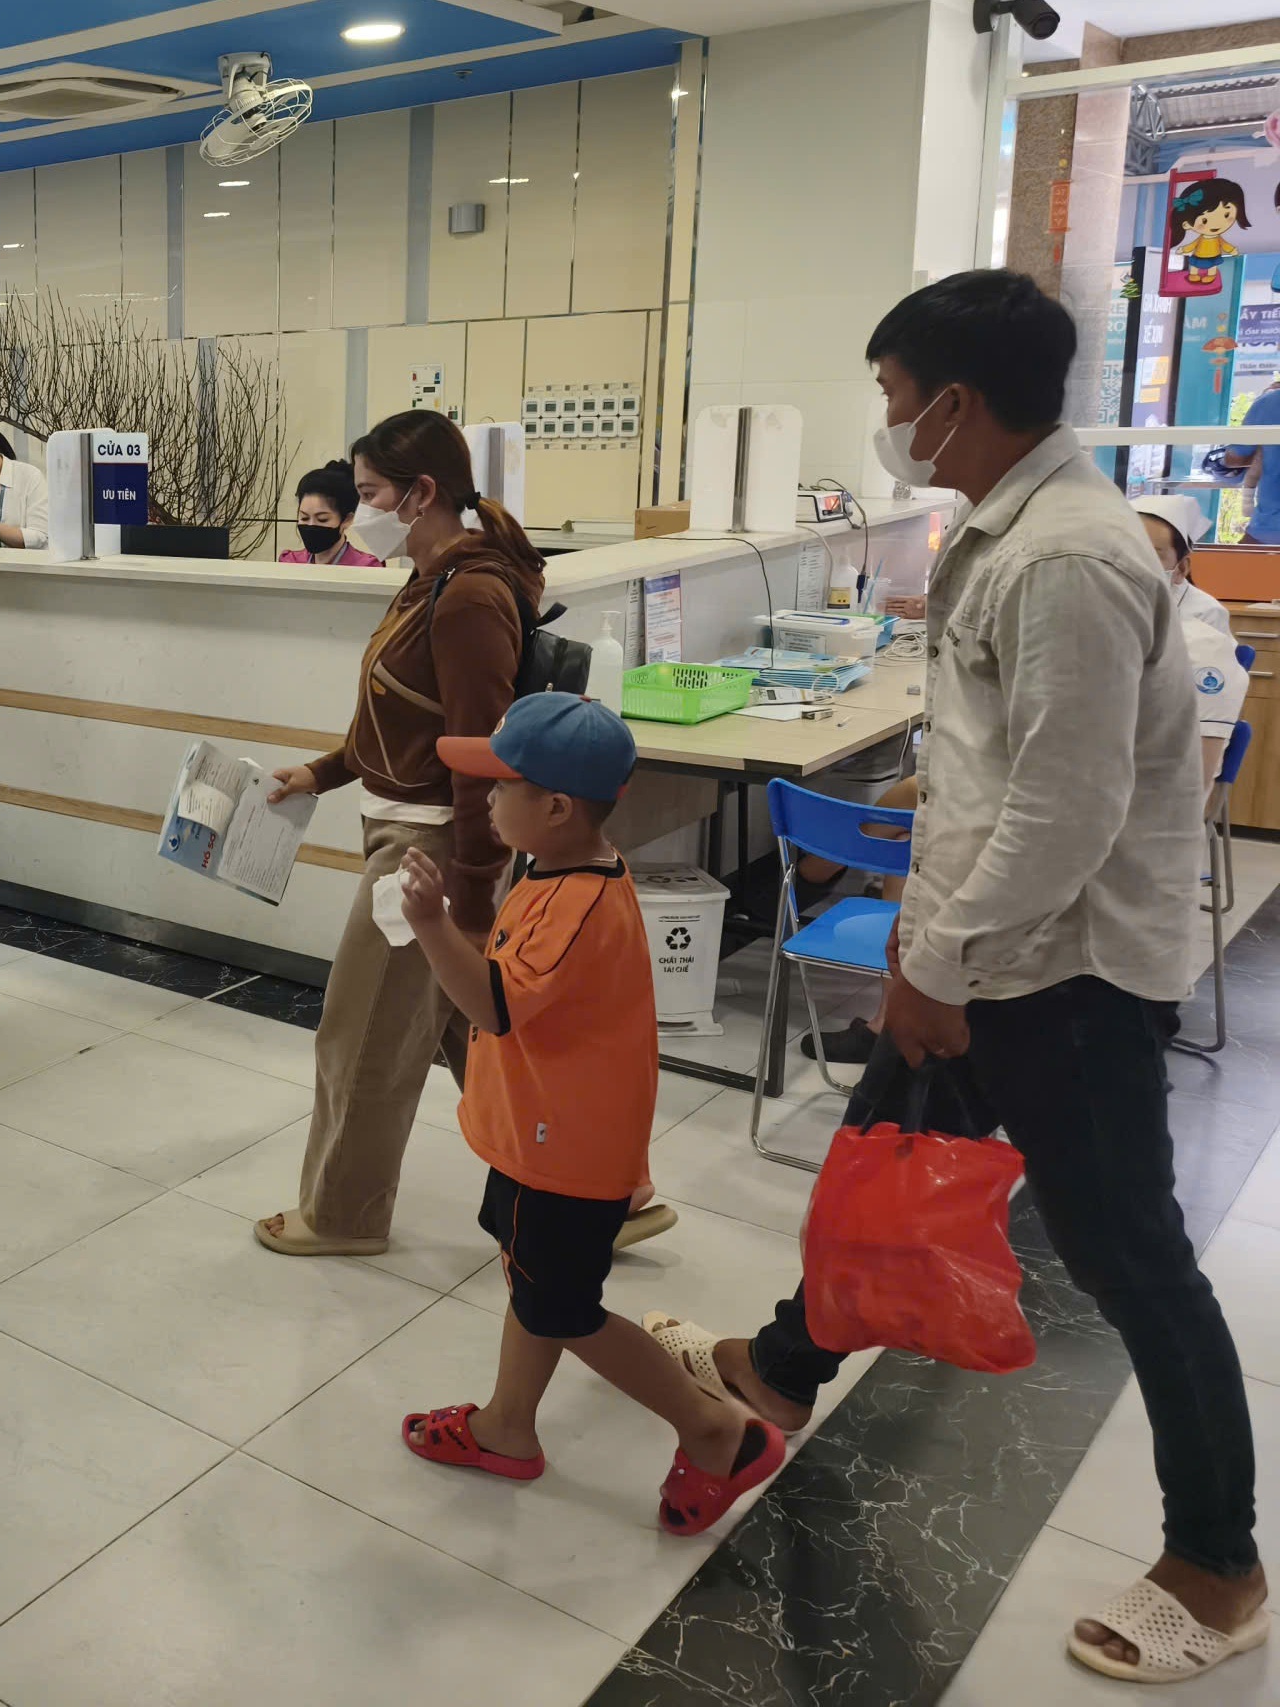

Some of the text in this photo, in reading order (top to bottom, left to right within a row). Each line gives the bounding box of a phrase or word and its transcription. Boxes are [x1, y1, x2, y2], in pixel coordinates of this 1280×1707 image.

[1261, 307, 1280, 319] TIẾ
[98, 440, 141, 456] CỬA 03
[103, 488, 136, 500] ƯU TIÊN
